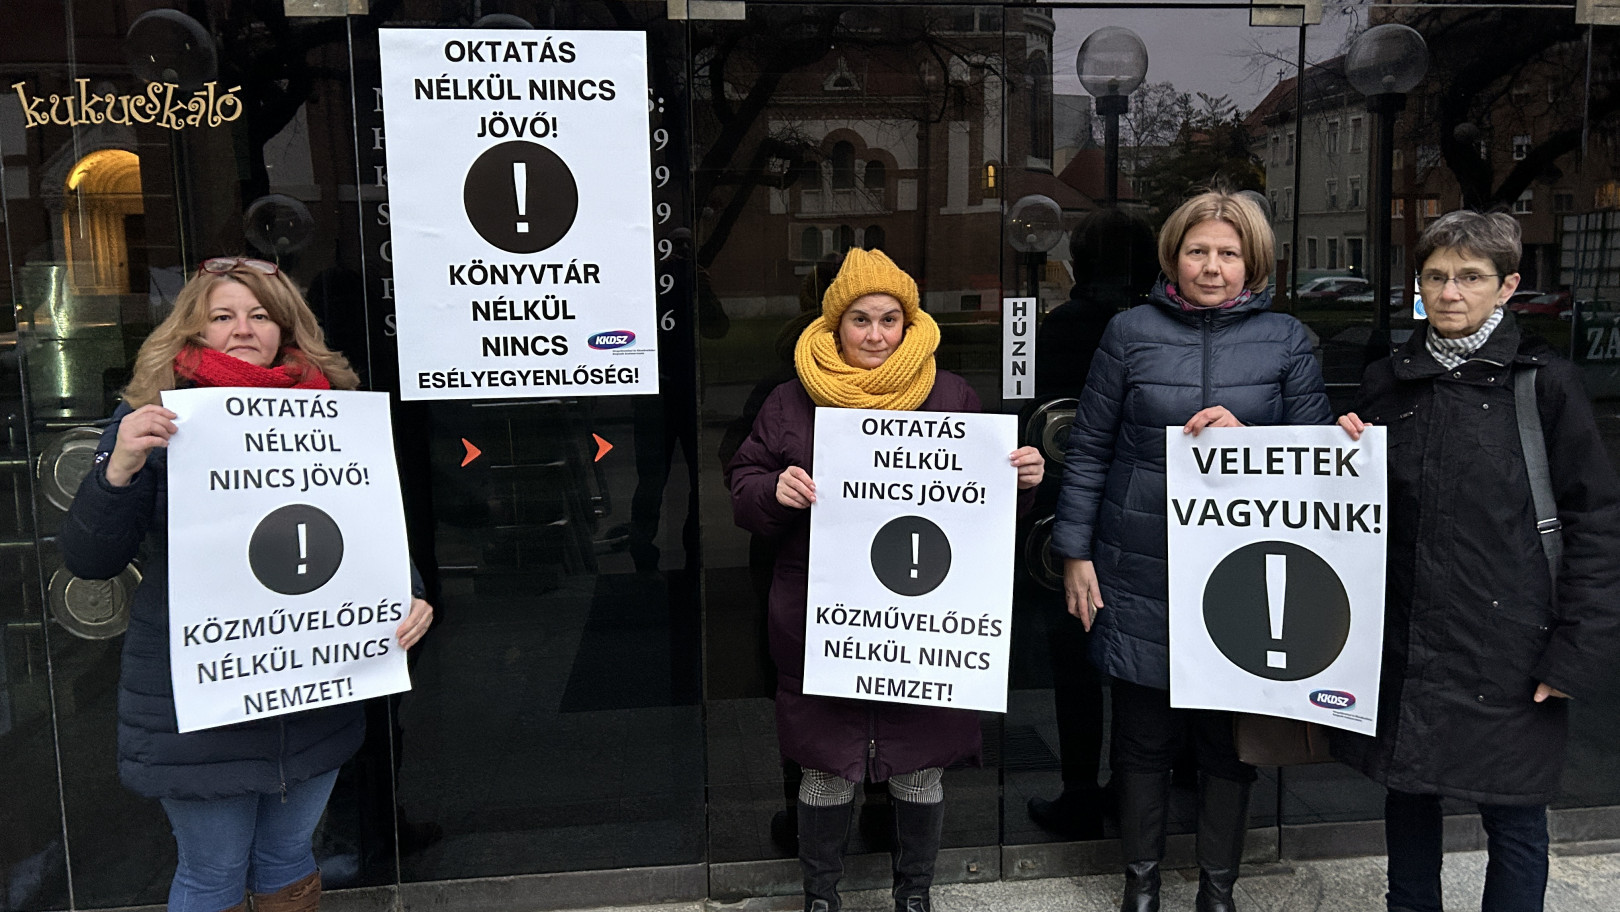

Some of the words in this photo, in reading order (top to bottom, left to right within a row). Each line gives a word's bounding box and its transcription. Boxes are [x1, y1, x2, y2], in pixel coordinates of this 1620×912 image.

[445, 37, 575, 63] OKTATÁS
[415, 74, 521, 100] NÉLKÜL
[529, 80, 615, 100] NINCS
[11, 78, 243, 130] kukucskáló
[478, 111, 557, 138] JÖVŐ!
[450, 259, 600, 285] KÖNYVTÁR
[472, 295, 575, 321] NÉLKÜL
[483, 336, 568, 356] NINCS
[595, 335, 628, 345] KKDSZ
[1012, 301, 1027, 396] HÚZNI
[419, 365, 639, 388] ESÉLYEGYENLŐSÉG!
[226, 395, 338, 418] OKTATÁS
[246, 429, 341, 451] NÉLKÜL
[862, 417, 965, 438] OKTATÁS
[875, 447, 962, 470] NÉLKÜL
[1192, 447, 1359, 477] VELETEK
[211, 469, 294, 490] NINCS
[301, 463, 369, 491] JÖVŐ!
[843, 482, 913, 500] NINCS
[918, 481, 985, 505] JÖVŐ!
[1172, 499, 1380, 533] VAGYUNK!
[183, 599, 403, 646] KÖZMŰVELŐDÉS
[816, 604, 1002, 637] KÖZMŰVELŐDÉS
[199, 647, 302, 683] NÉLKÜL
[313, 638, 389, 665] NINCS
[825, 637, 910, 663] NÉLKÜL
[920, 648, 989, 670] NINCS
[244, 677, 354, 715] NEMZET!
[856, 675, 953, 702] NEMZET!
[1317, 692, 1349, 707] KKDSZ
